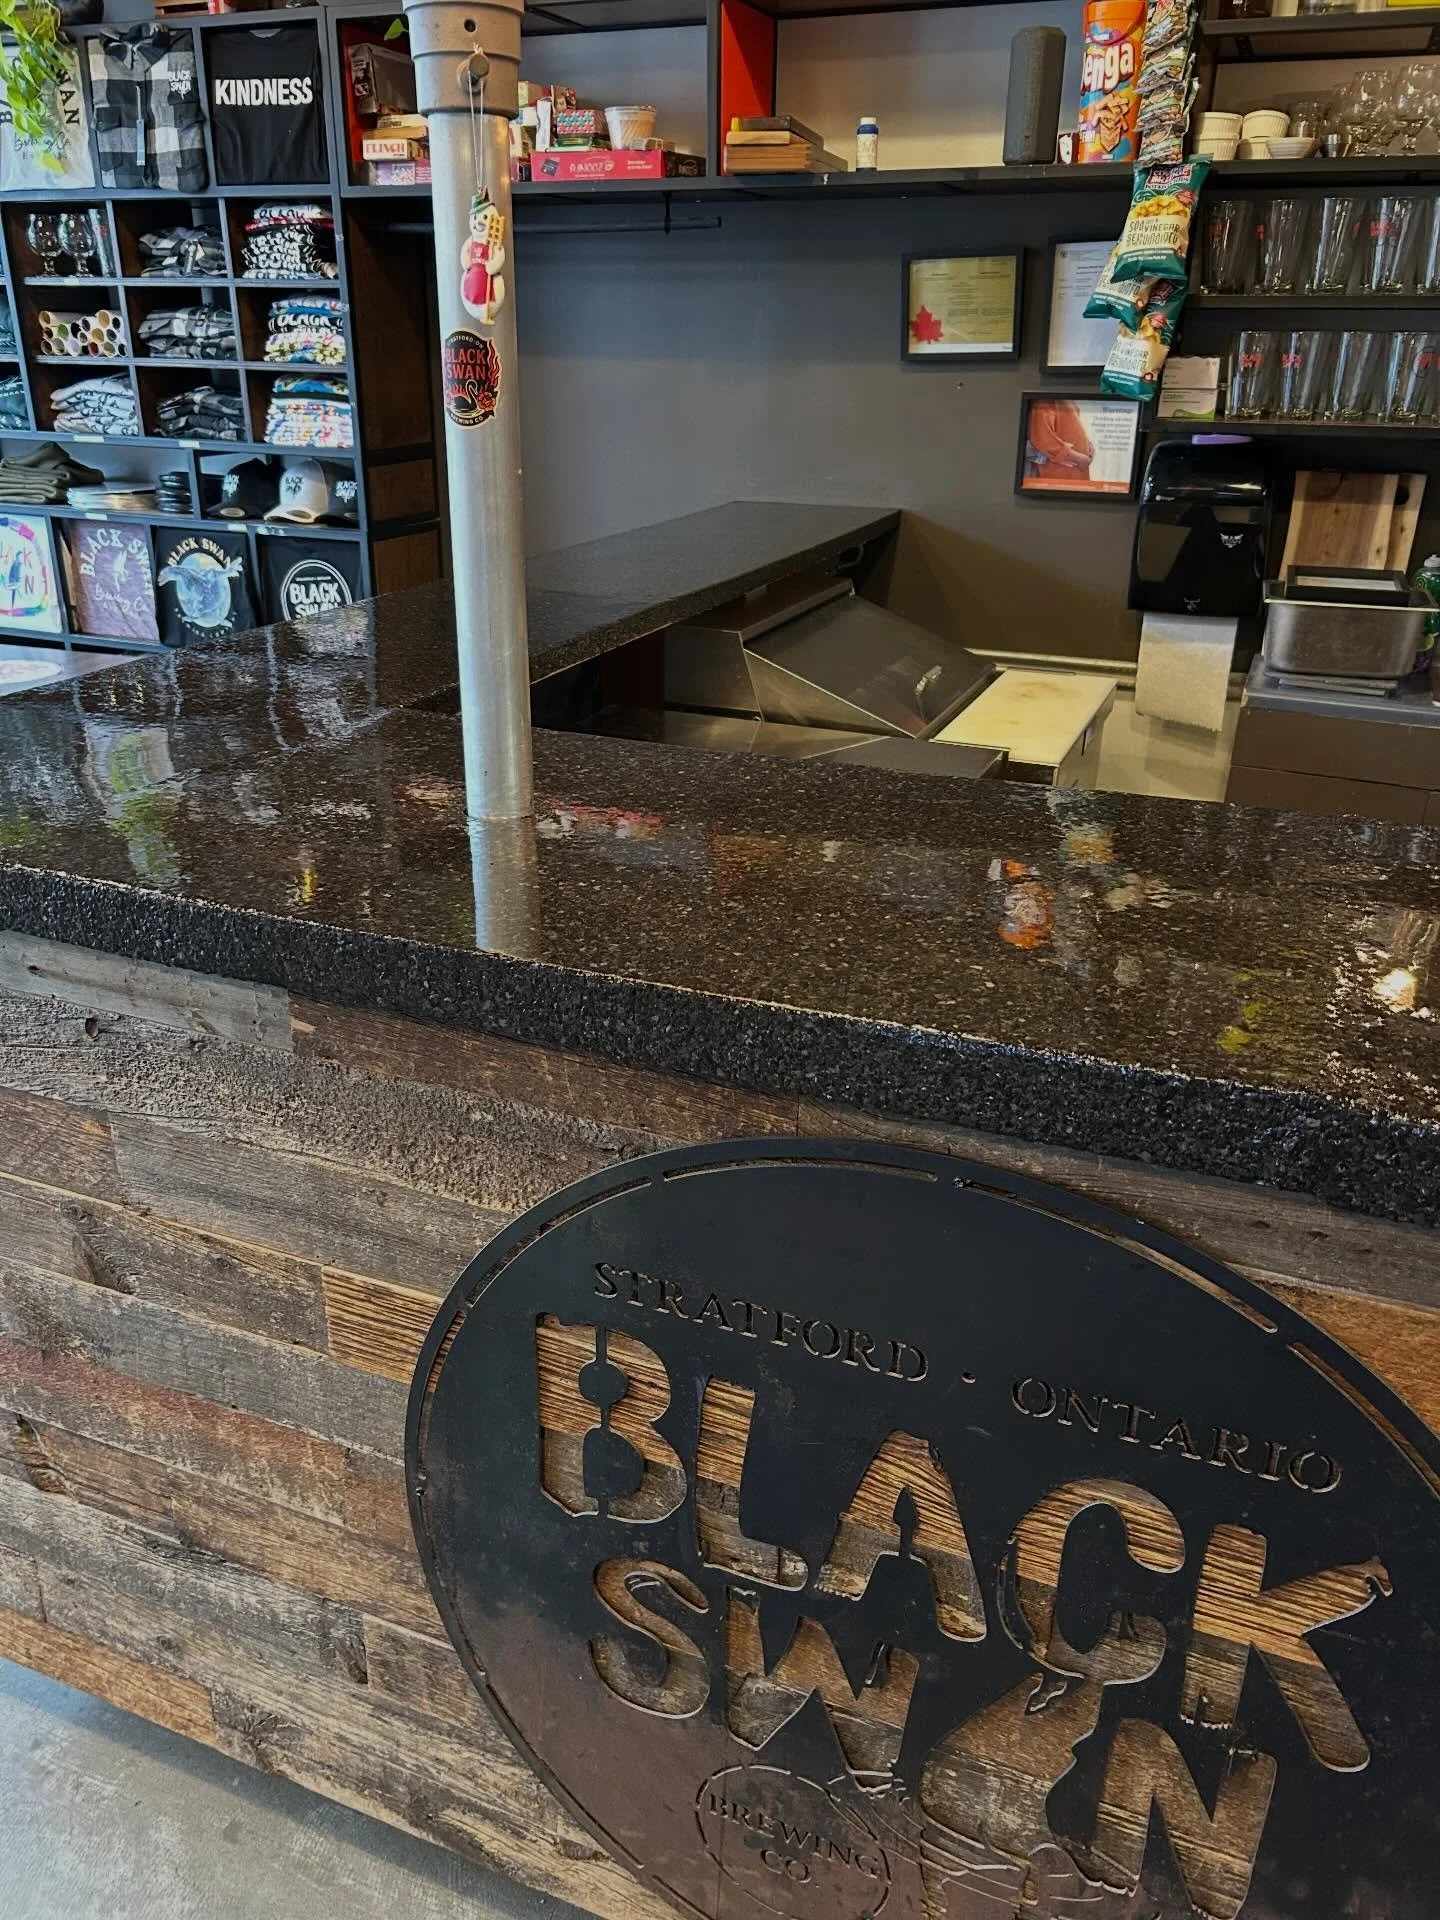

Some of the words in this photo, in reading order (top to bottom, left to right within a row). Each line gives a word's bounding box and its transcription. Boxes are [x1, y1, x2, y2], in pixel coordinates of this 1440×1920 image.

[215, 77, 313, 106] KINDNESS
[446, 347, 486, 364] BLACK
[446, 364, 486, 380] SWAN
[80, 528, 123, 577] BLACK
[168, 537, 200, 567] BLACK
[289, 582, 341, 604] BLACK
[593, 1262, 929, 1382] STRATFORD
[1011, 1375, 1344, 1494] ONTARIO
[535, 1312, 1394, 1774] BLACK
[588, 1556, 1277, 1920] SWAN
[709, 1793, 881, 1879] BREWING
